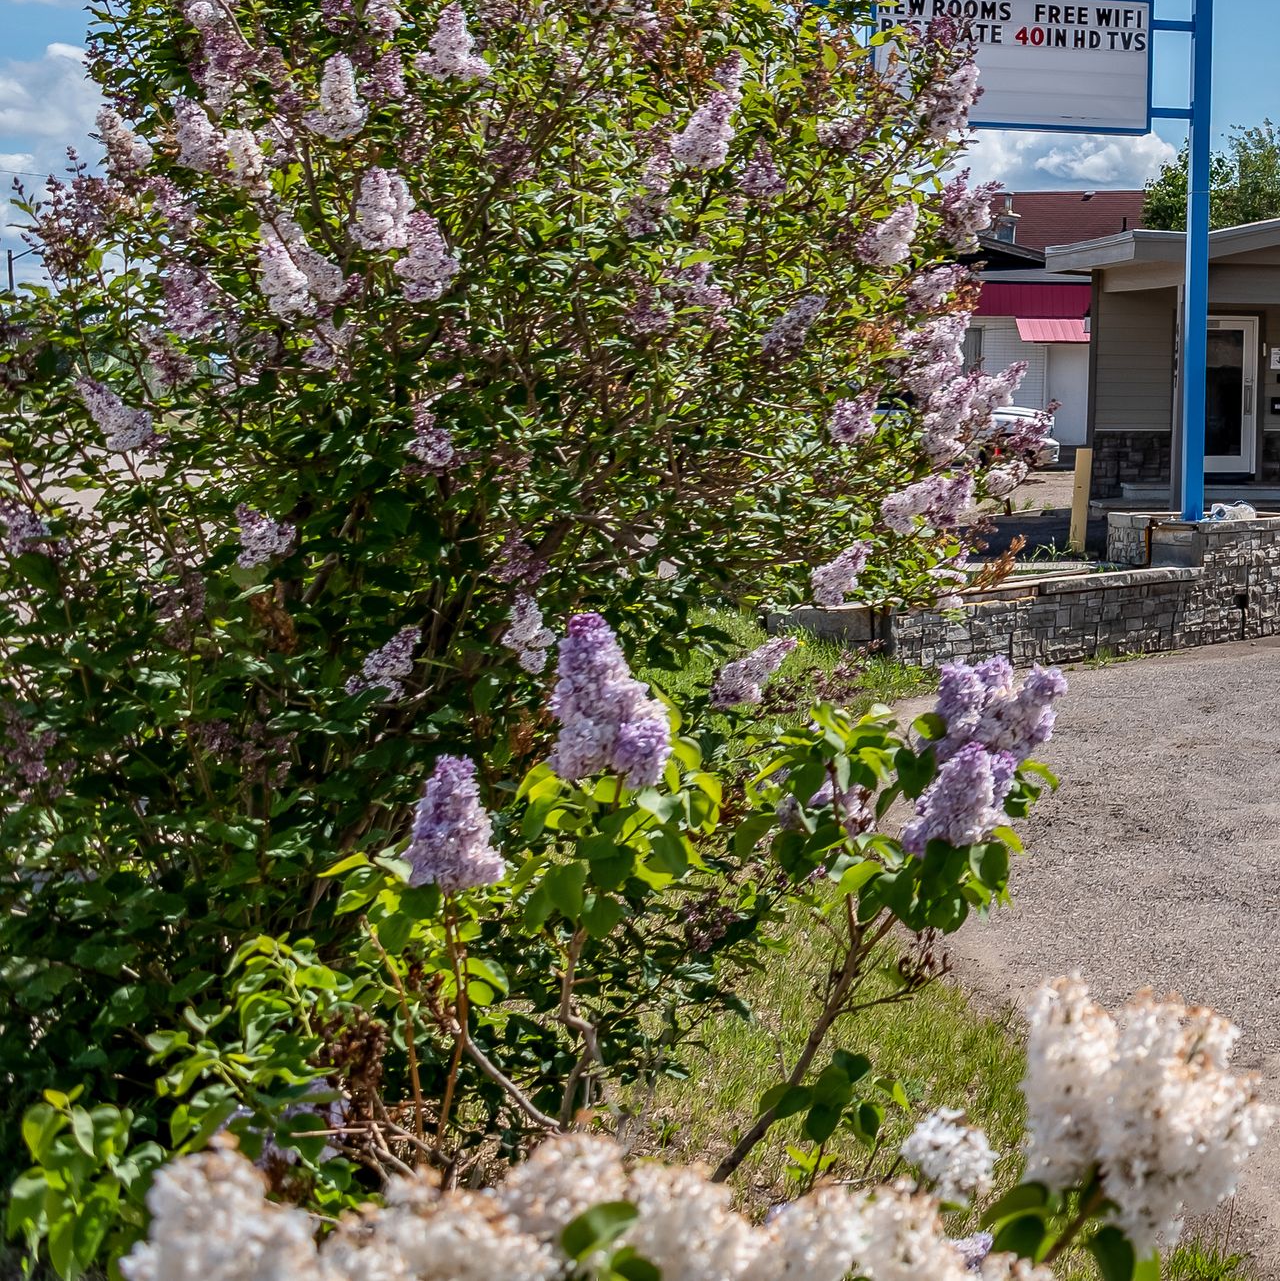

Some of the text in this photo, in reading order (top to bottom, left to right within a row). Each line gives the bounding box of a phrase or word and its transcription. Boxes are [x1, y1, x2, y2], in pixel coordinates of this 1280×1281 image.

[1034, 3, 1089, 26] FREE
[1095, 7, 1142, 29] WIFI
[1073, 29, 1101, 49] HD
[1107, 31, 1146, 52] TVS
